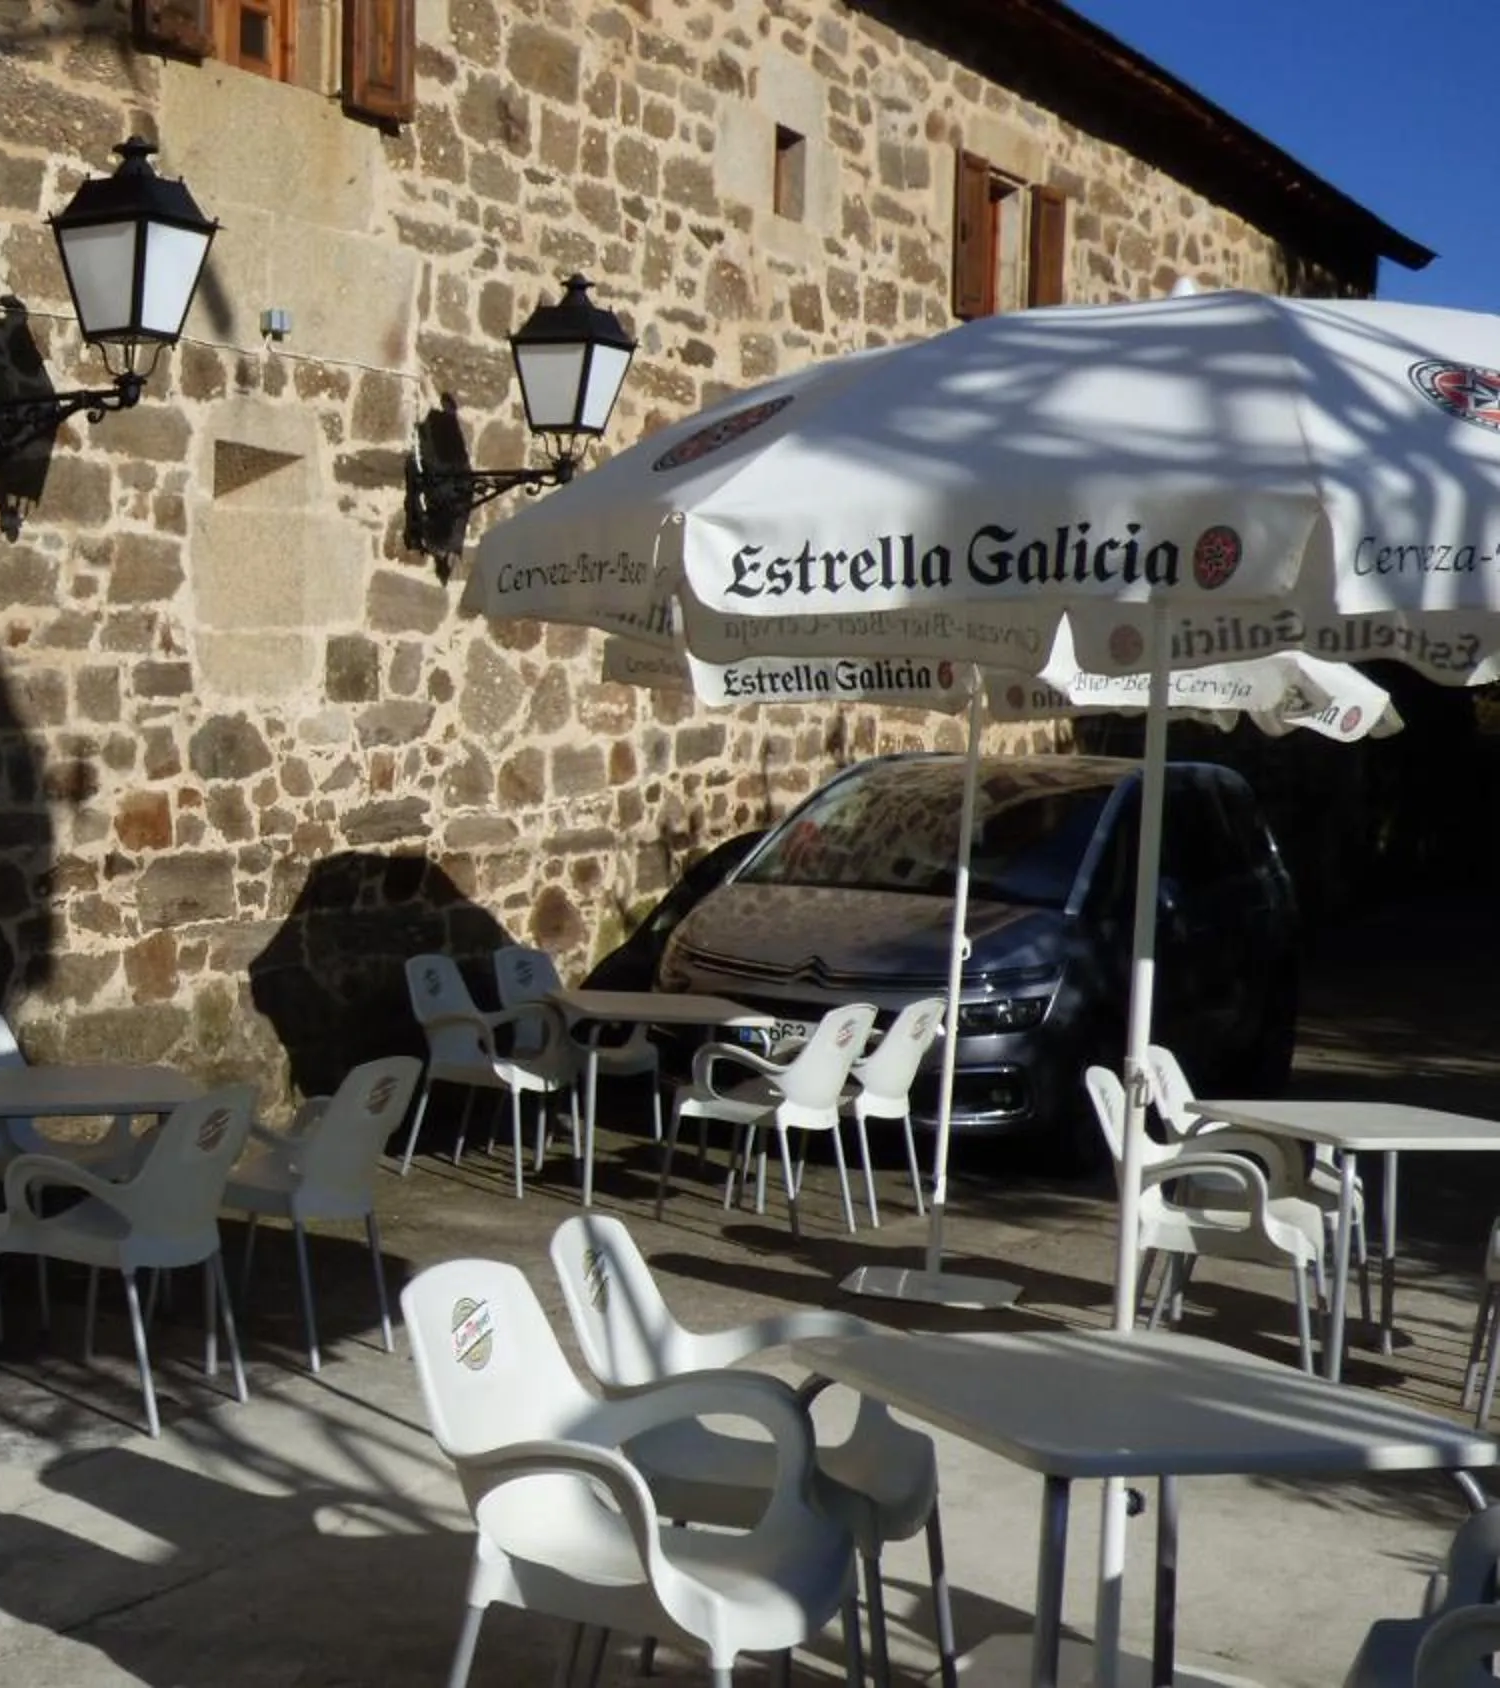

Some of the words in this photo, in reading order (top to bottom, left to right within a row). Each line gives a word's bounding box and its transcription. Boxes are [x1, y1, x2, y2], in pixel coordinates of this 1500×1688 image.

[724, 532, 953, 598] Estrella
[967, 522, 1180, 587] Galicia
[723, 665, 831, 697] Estrella
[835, 659, 931, 692] Galicia
